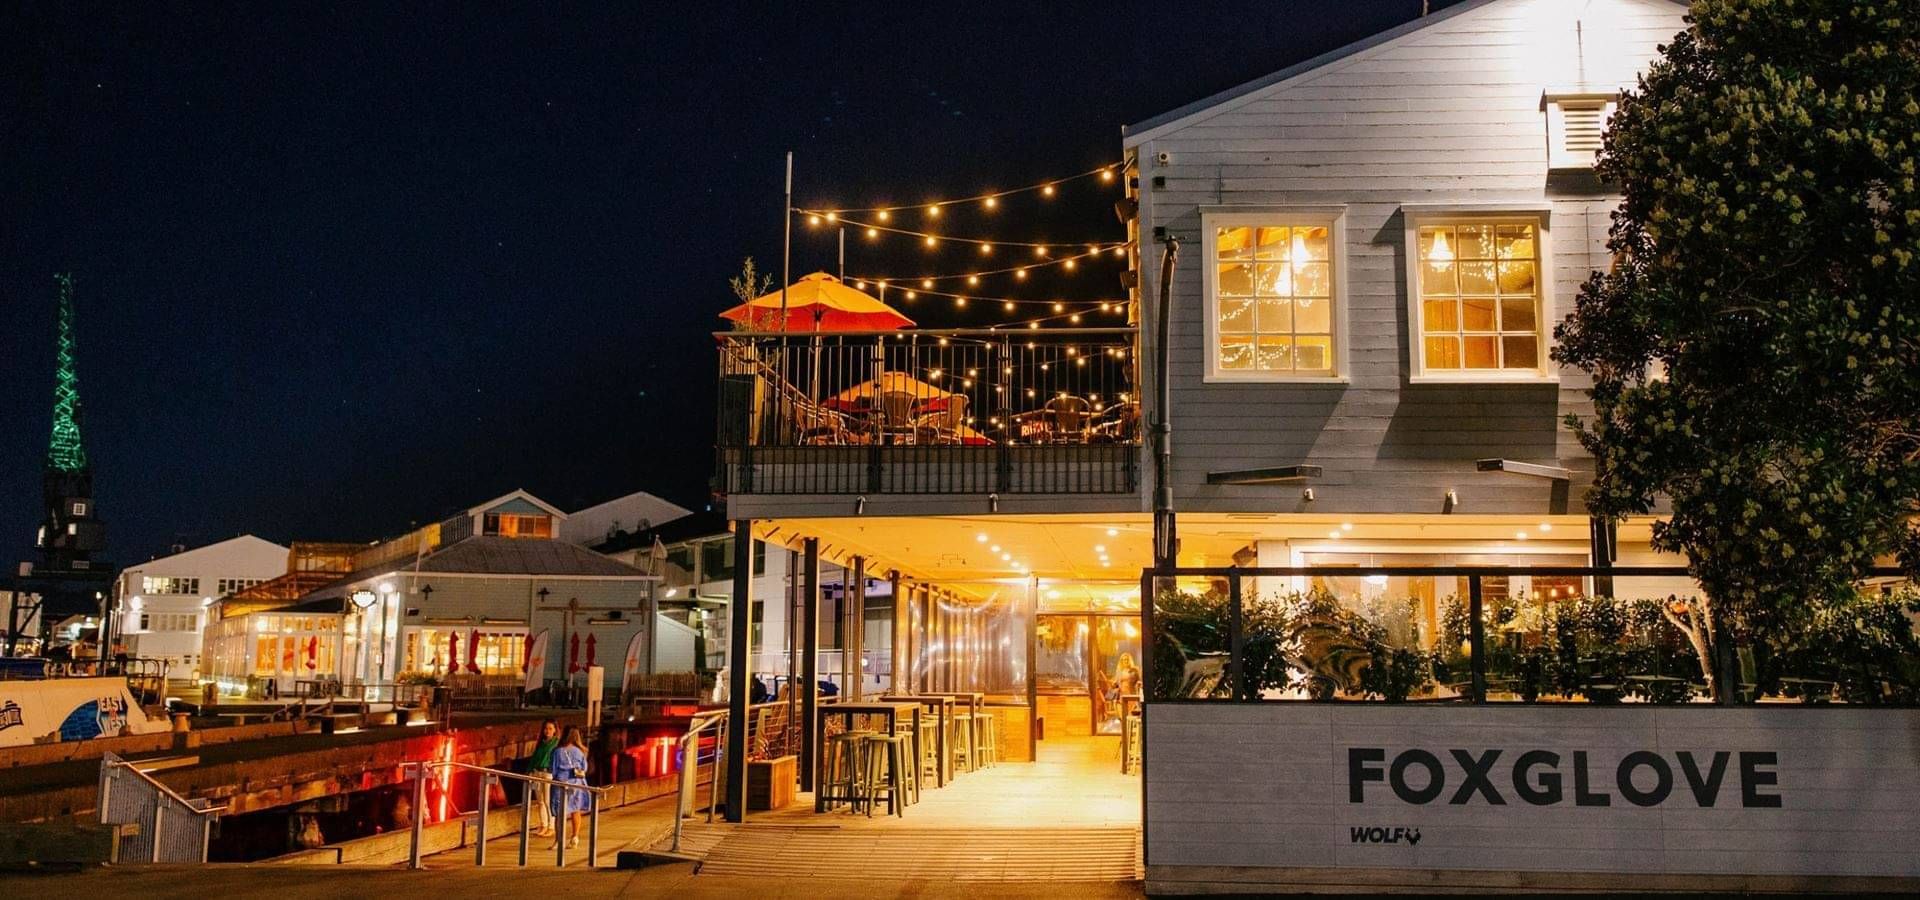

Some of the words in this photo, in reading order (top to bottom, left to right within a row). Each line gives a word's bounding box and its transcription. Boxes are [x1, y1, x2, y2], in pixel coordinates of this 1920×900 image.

[99, 696, 123, 712] EAST
[1348, 747, 1783, 808] FOXGLOVE
[1350, 826, 1404, 844] WOLF
